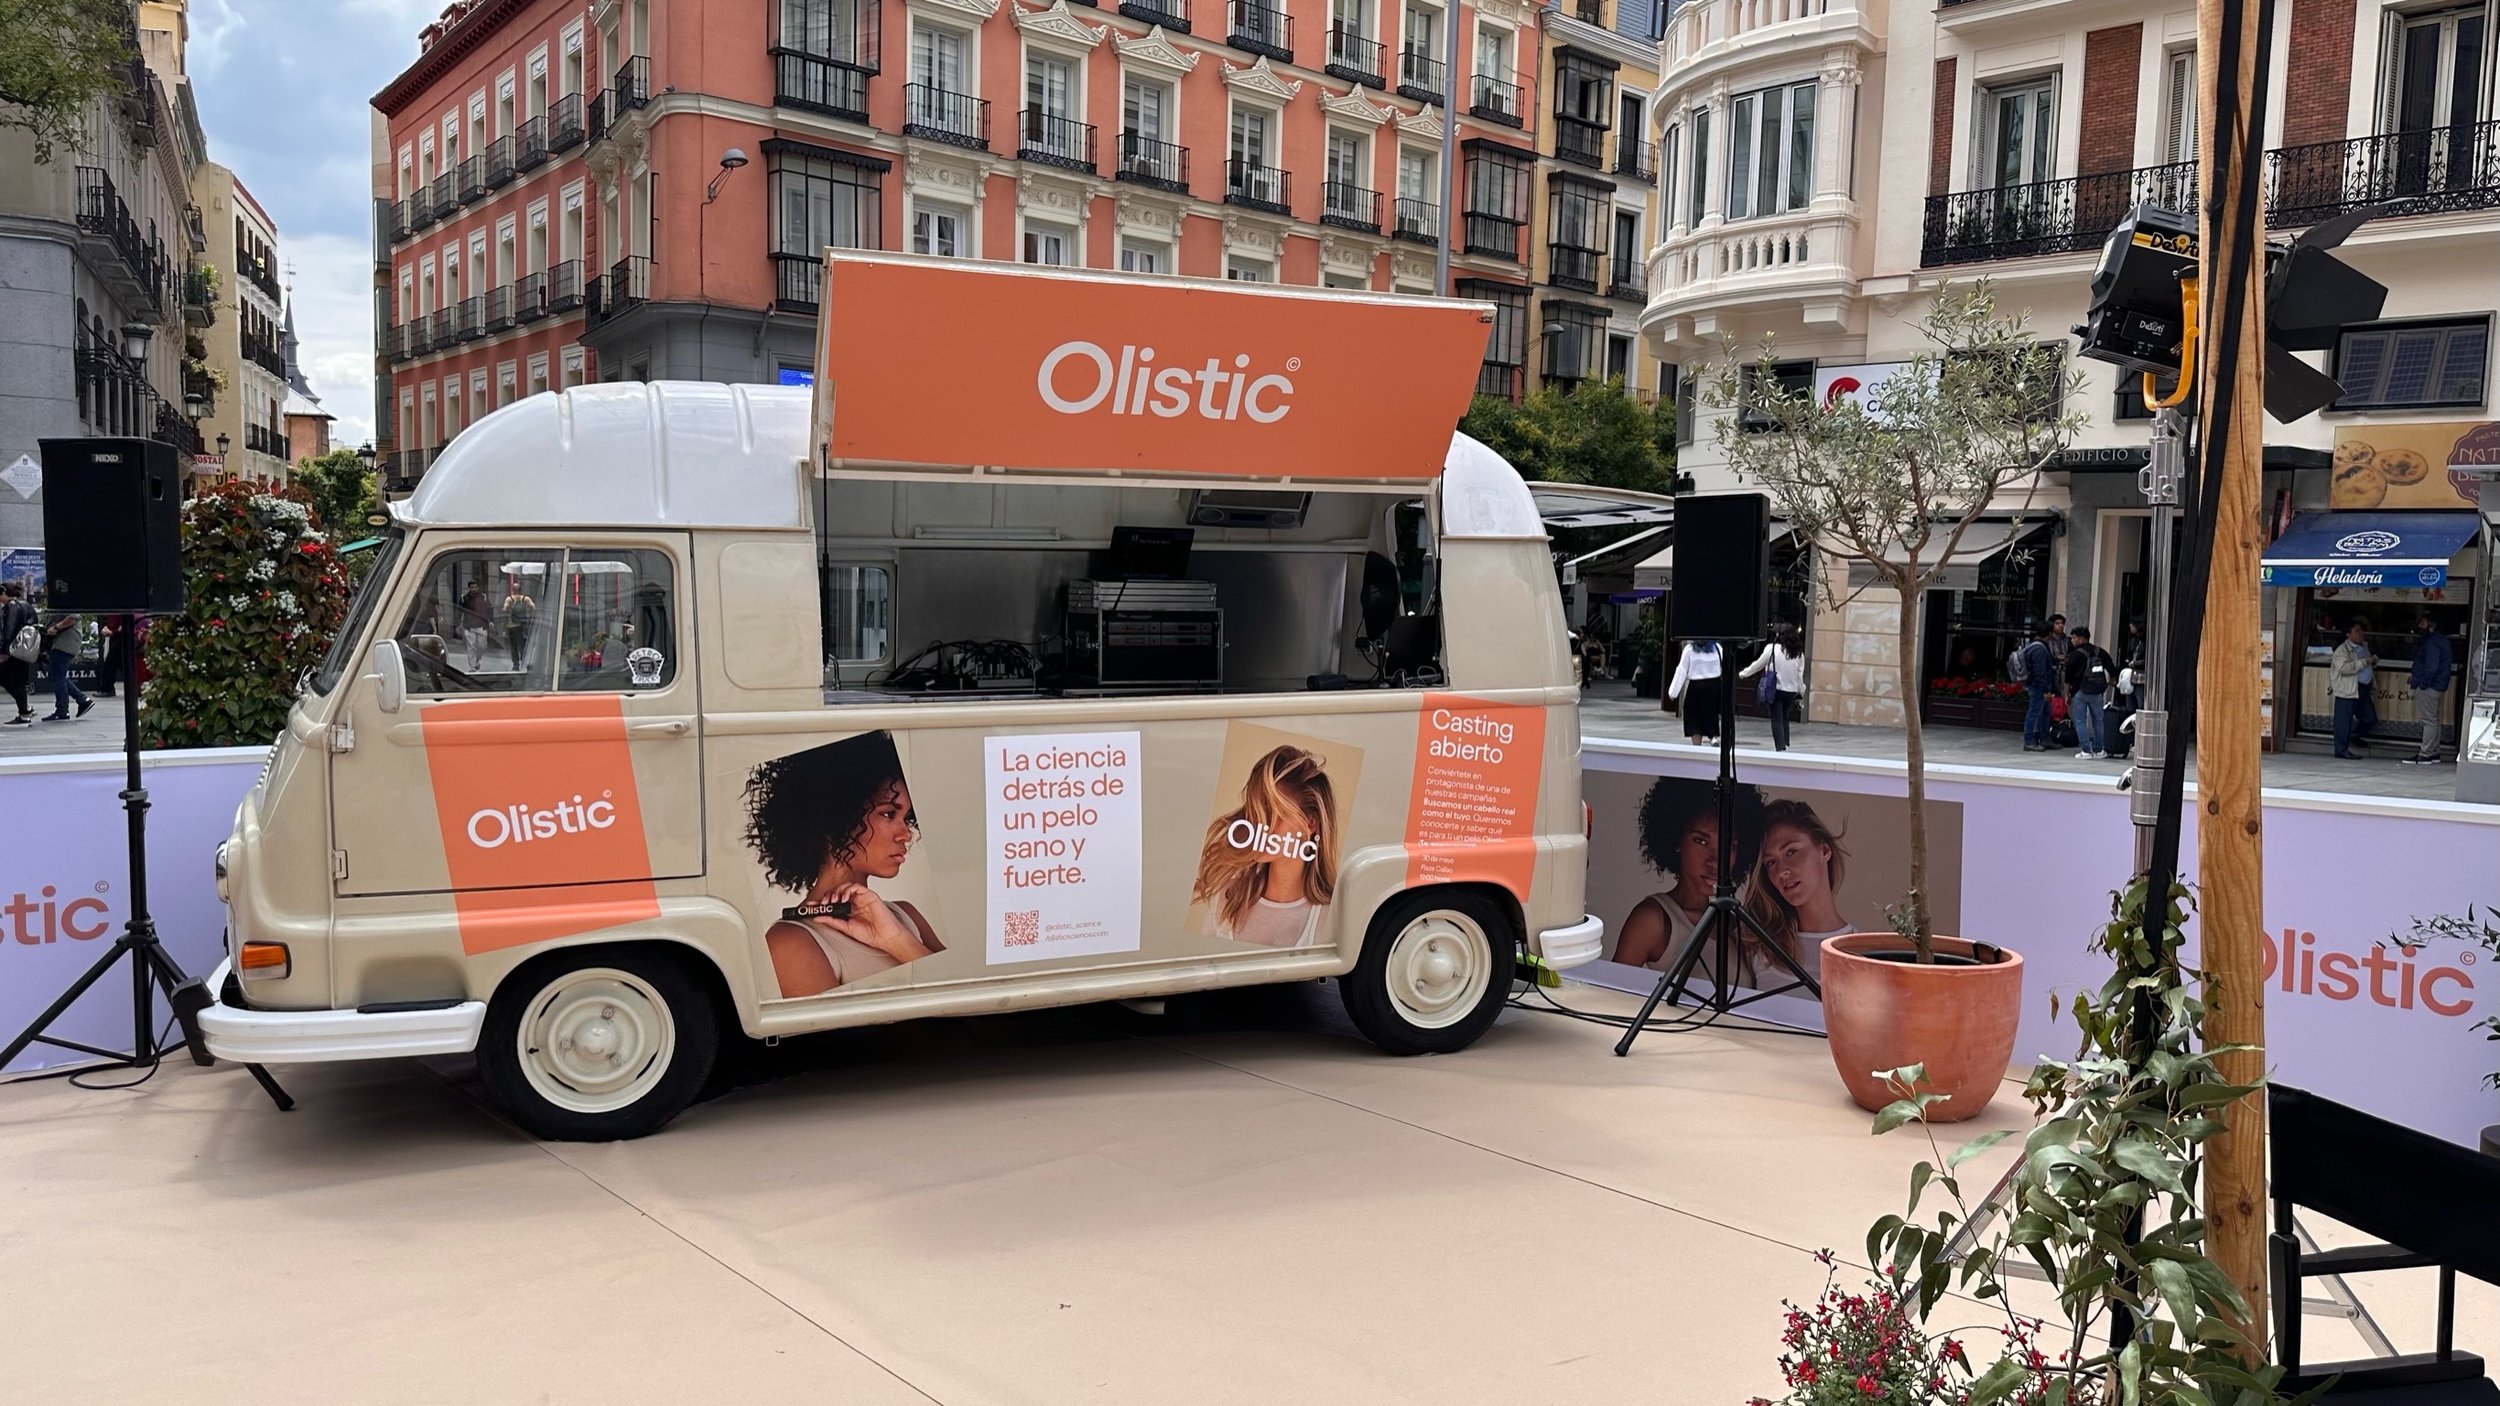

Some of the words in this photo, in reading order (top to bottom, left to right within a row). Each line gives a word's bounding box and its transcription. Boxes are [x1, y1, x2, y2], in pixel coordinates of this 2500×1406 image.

[1037, 341, 1294, 423] Olistic
[95, 454, 119, 462] NEXO
[2064, 449, 2129, 462] EDIFICIO
[2314, 567, 2383, 586] Heladería
[36, 670, 96, 679] RILLA
[1432, 709, 1514, 744] Casting
[1003, 748, 1029, 772] La
[1036, 744, 1126, 770] ciencia
[1430, 735, 1503, 764] abierto
[1427, 765, 1472, 779] Conviértete
[1003, 775, 1086, 801] detrás
[1091, 772, 1124, 796] de
[1425, 788, 1457, 798] nuestras
[1426, 778, 1474, 790] protagonista
[1475, 783, 1486, 791] de
[1500, 786, 1511, 794] de
[1424, 798, 1462, 810] Buscamos
[1463, 802, 1472, 810] un
[1474, 804, 1500, 814] cabello
[1502, 808, 1516, 816] real
[468, 794, 616, 848] Olistic
[1004, 812, 1035, 830] un
[1042, 803, 1098, 834] pelo
[1420, 820, 1460, 830] conocerte
[1460, 824, 1466, 832] y
[1466, 824, 1487, 834] saber
[1422, 810, 1444, 818] como
[1472, 814, 1512, 826] Queremos
[1227, 819, 1317, 862] Olistic
[1428, 831, 1446, 840] para
[1004, 839, 1066, 860] sano
[1071, 838, 1086, 860] y
[1004, 864, 1086, 888] fuerte.
[0, 885, 110, 946] tic
[798, 904, 834, 916] Olistic
